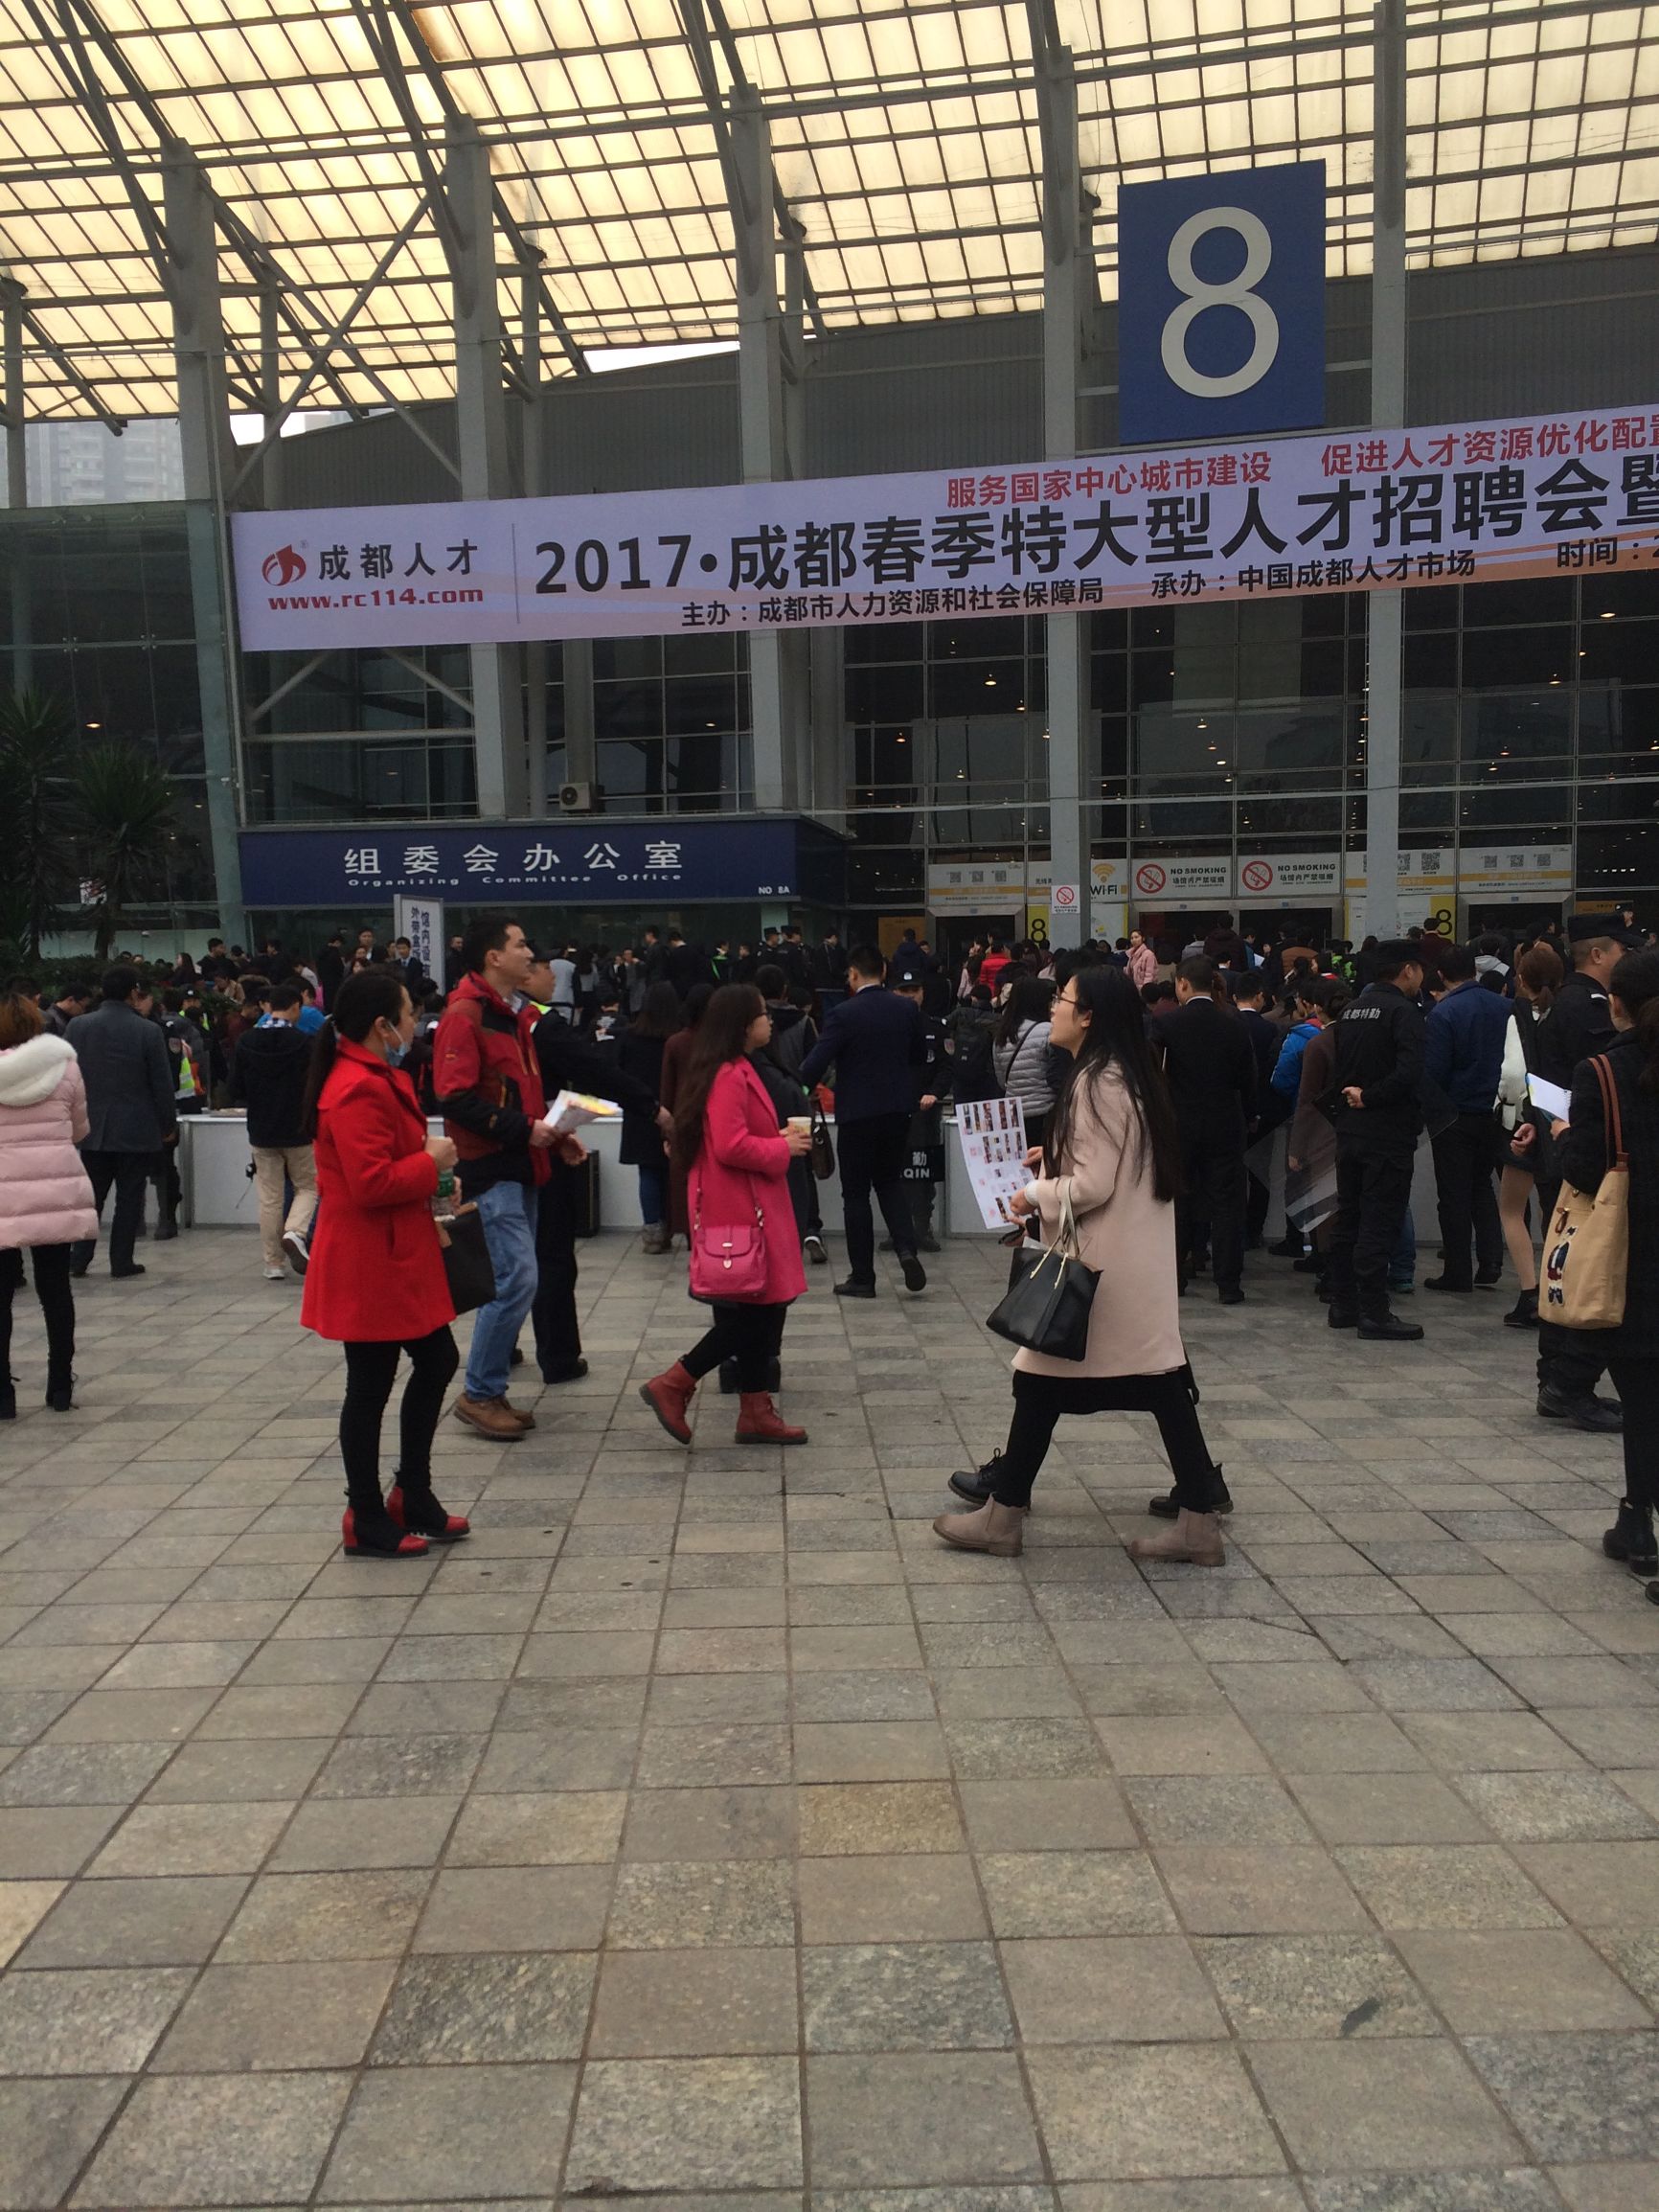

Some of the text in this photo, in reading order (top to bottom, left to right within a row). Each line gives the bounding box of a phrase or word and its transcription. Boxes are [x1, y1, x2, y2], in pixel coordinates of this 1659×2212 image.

[1161, 206, 1280, 399] 8
[946, 450, 1272, 509] 服务国家中心城市建设
[318, 538, 478, 582] 成都人才
[267, 587, 484, 611] www.rc114.com
[681, 577, 1103, 627] 主办：成都市人力资源和社会保障局
[1150, 549, 1476, 600] 承办：中国成都人才市场
[344, 840, 683, 876] 组委会办公室
[1184, 866, 1227, 875] SMOKING
[348, 873, 682, 887] Organizing Committee Office
[1031, 918, 1047, 943] 8
[1436, 909, 1453, 936] 8
[903, 1168, 930, 1178] QIN
